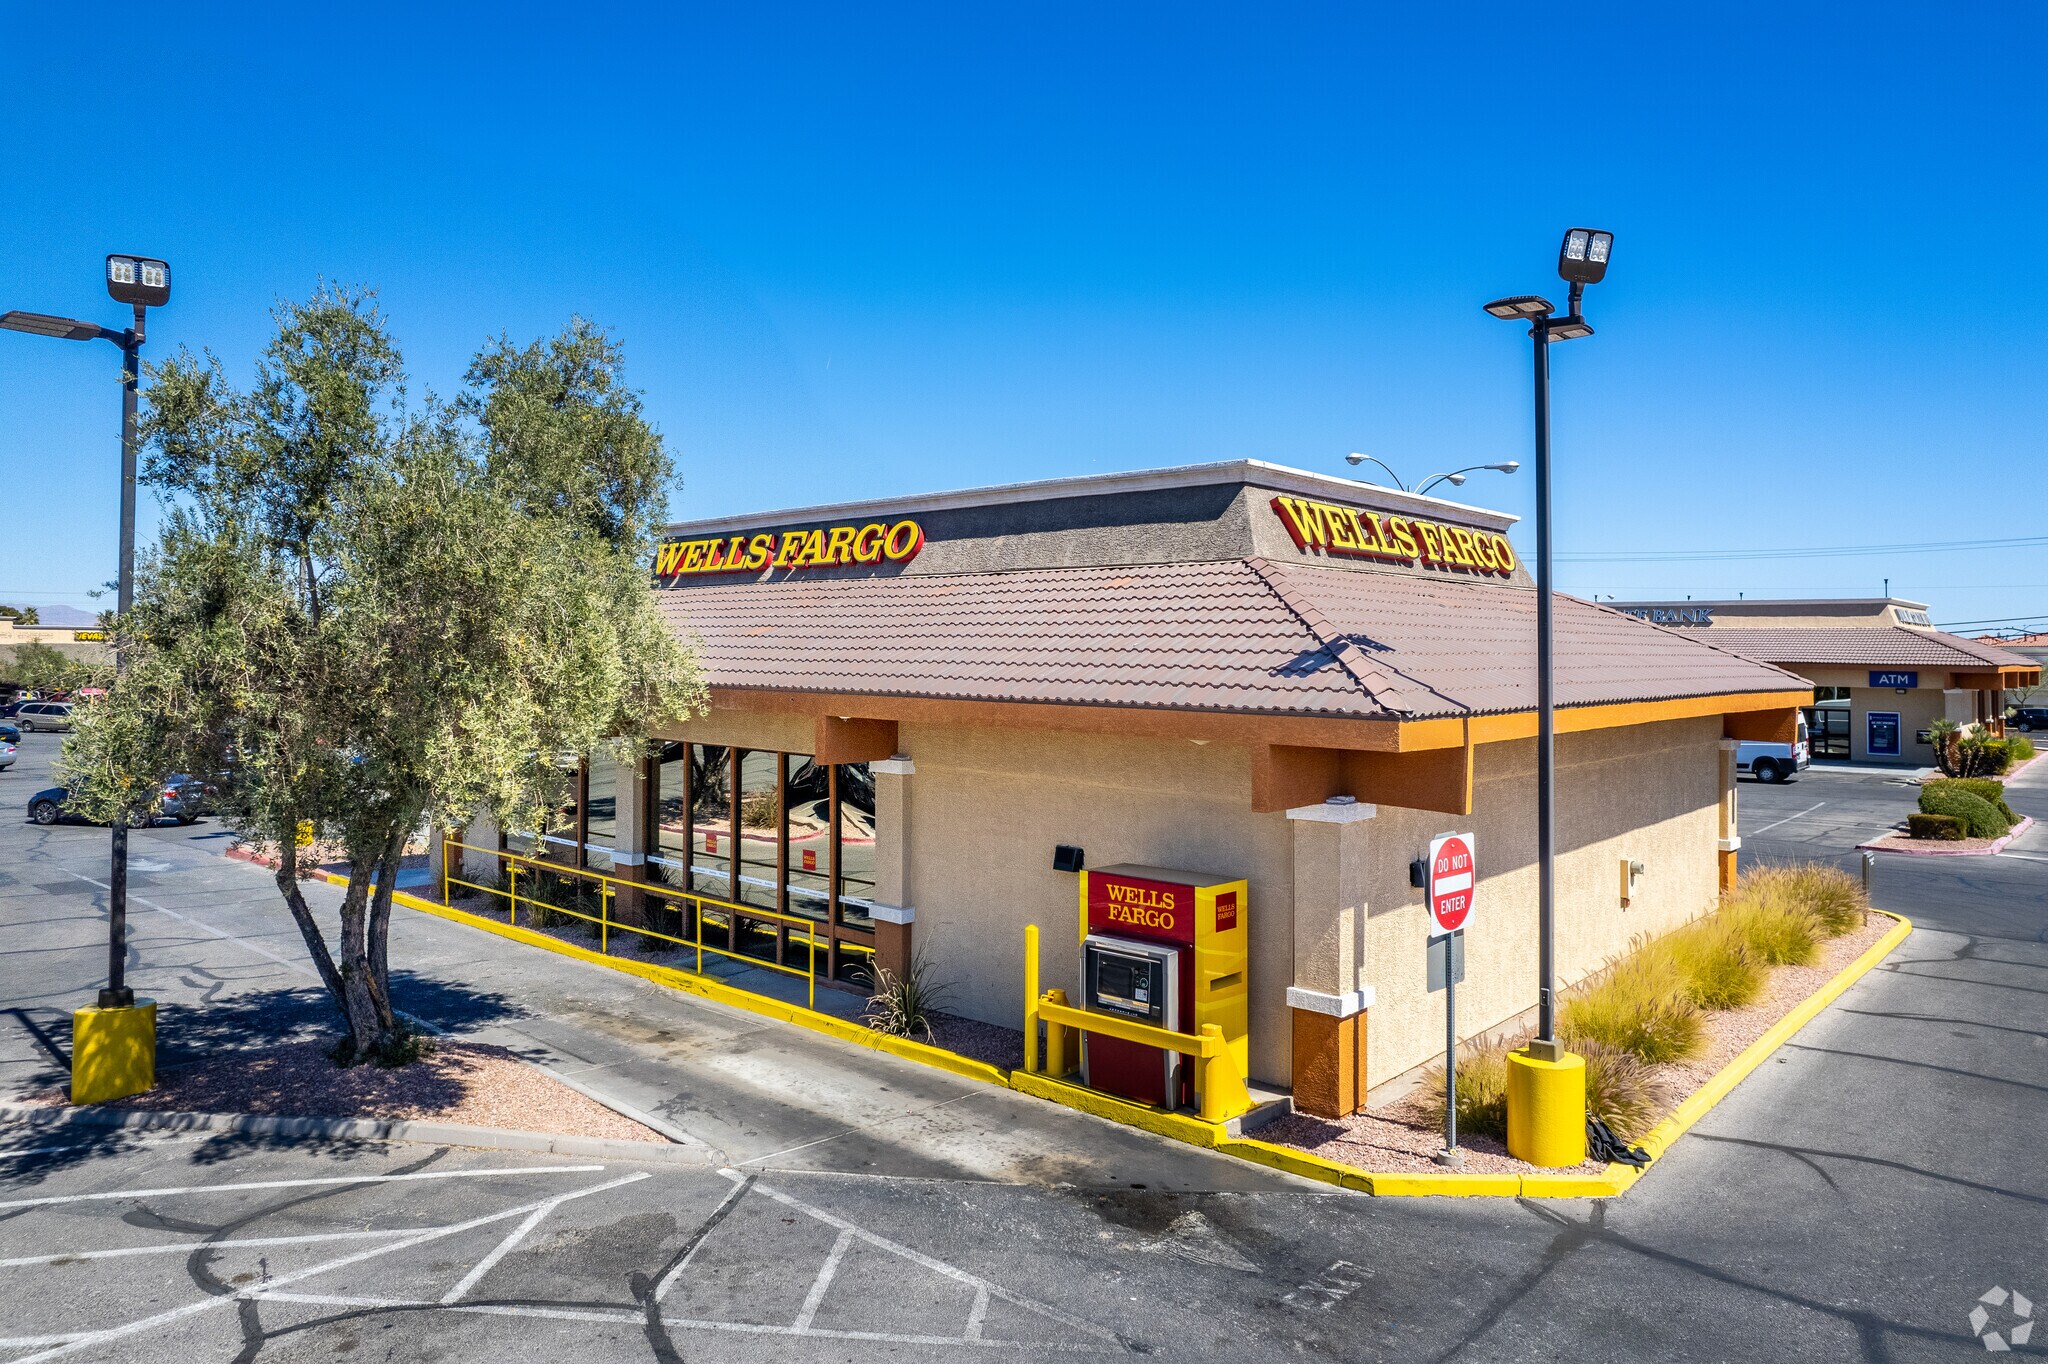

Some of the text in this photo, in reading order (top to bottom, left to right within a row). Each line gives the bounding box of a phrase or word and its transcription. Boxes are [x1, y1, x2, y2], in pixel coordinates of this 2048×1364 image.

[1272, 496, 1517, 574] WELLS FARGO
[655, 519, 924, 577] WELLS FARGO
[1652, 608, 1714, 623] BANK
[1878, 674, 1909, 684] ATM
[1438, 854, 1468, 872] DO NOT
[1106, 884, 1175, 910] WELLS
[1441, 896, 1465, 914] ENTER
[1108, 904, 1175, 929] FARGO
[1217, 904, 1235, 912] WELLS
[1217, 911, 1235, 920] FARGO
